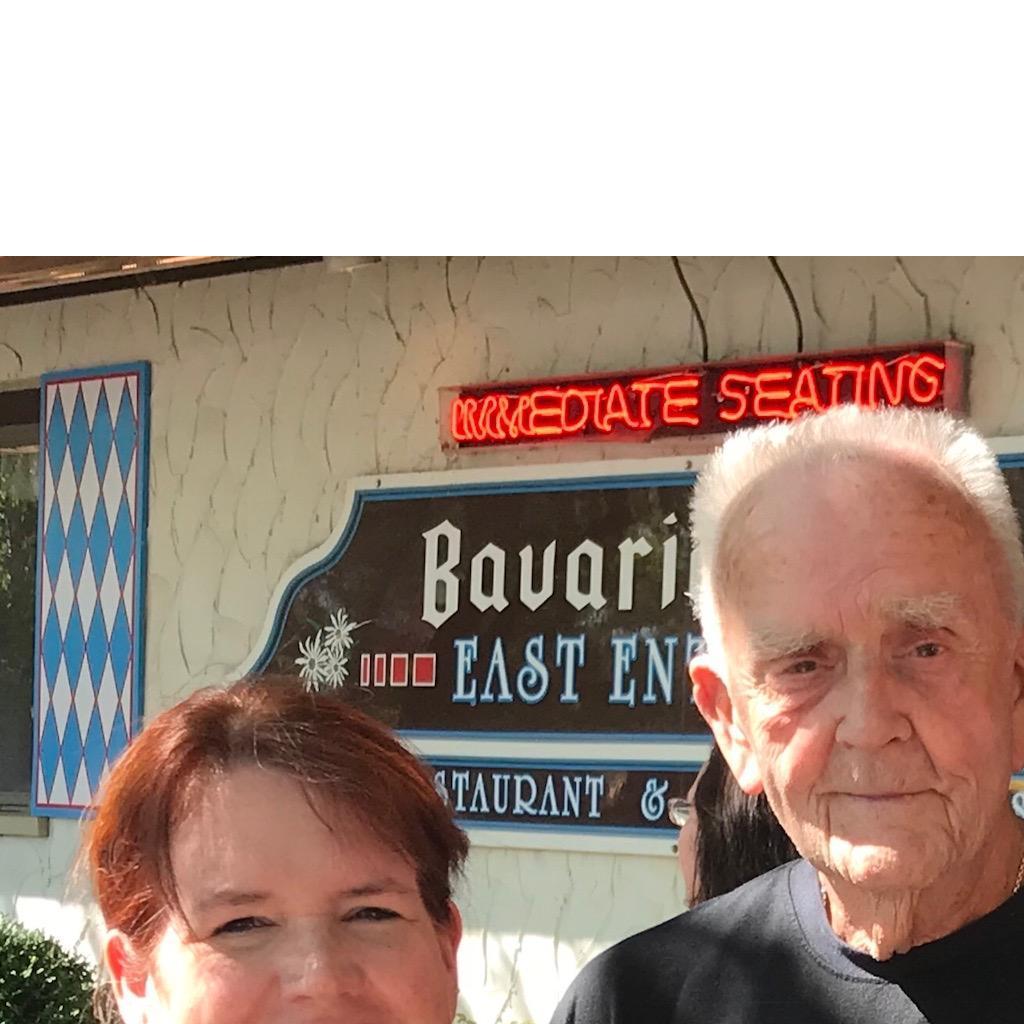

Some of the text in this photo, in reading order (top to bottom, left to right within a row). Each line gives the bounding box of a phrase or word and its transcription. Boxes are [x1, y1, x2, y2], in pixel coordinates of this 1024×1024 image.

[450, 353, 946, 440] IMMEDIATE SEATING
[452, 633, 586, 707] EAST
[640, 777, 669, 821] &
